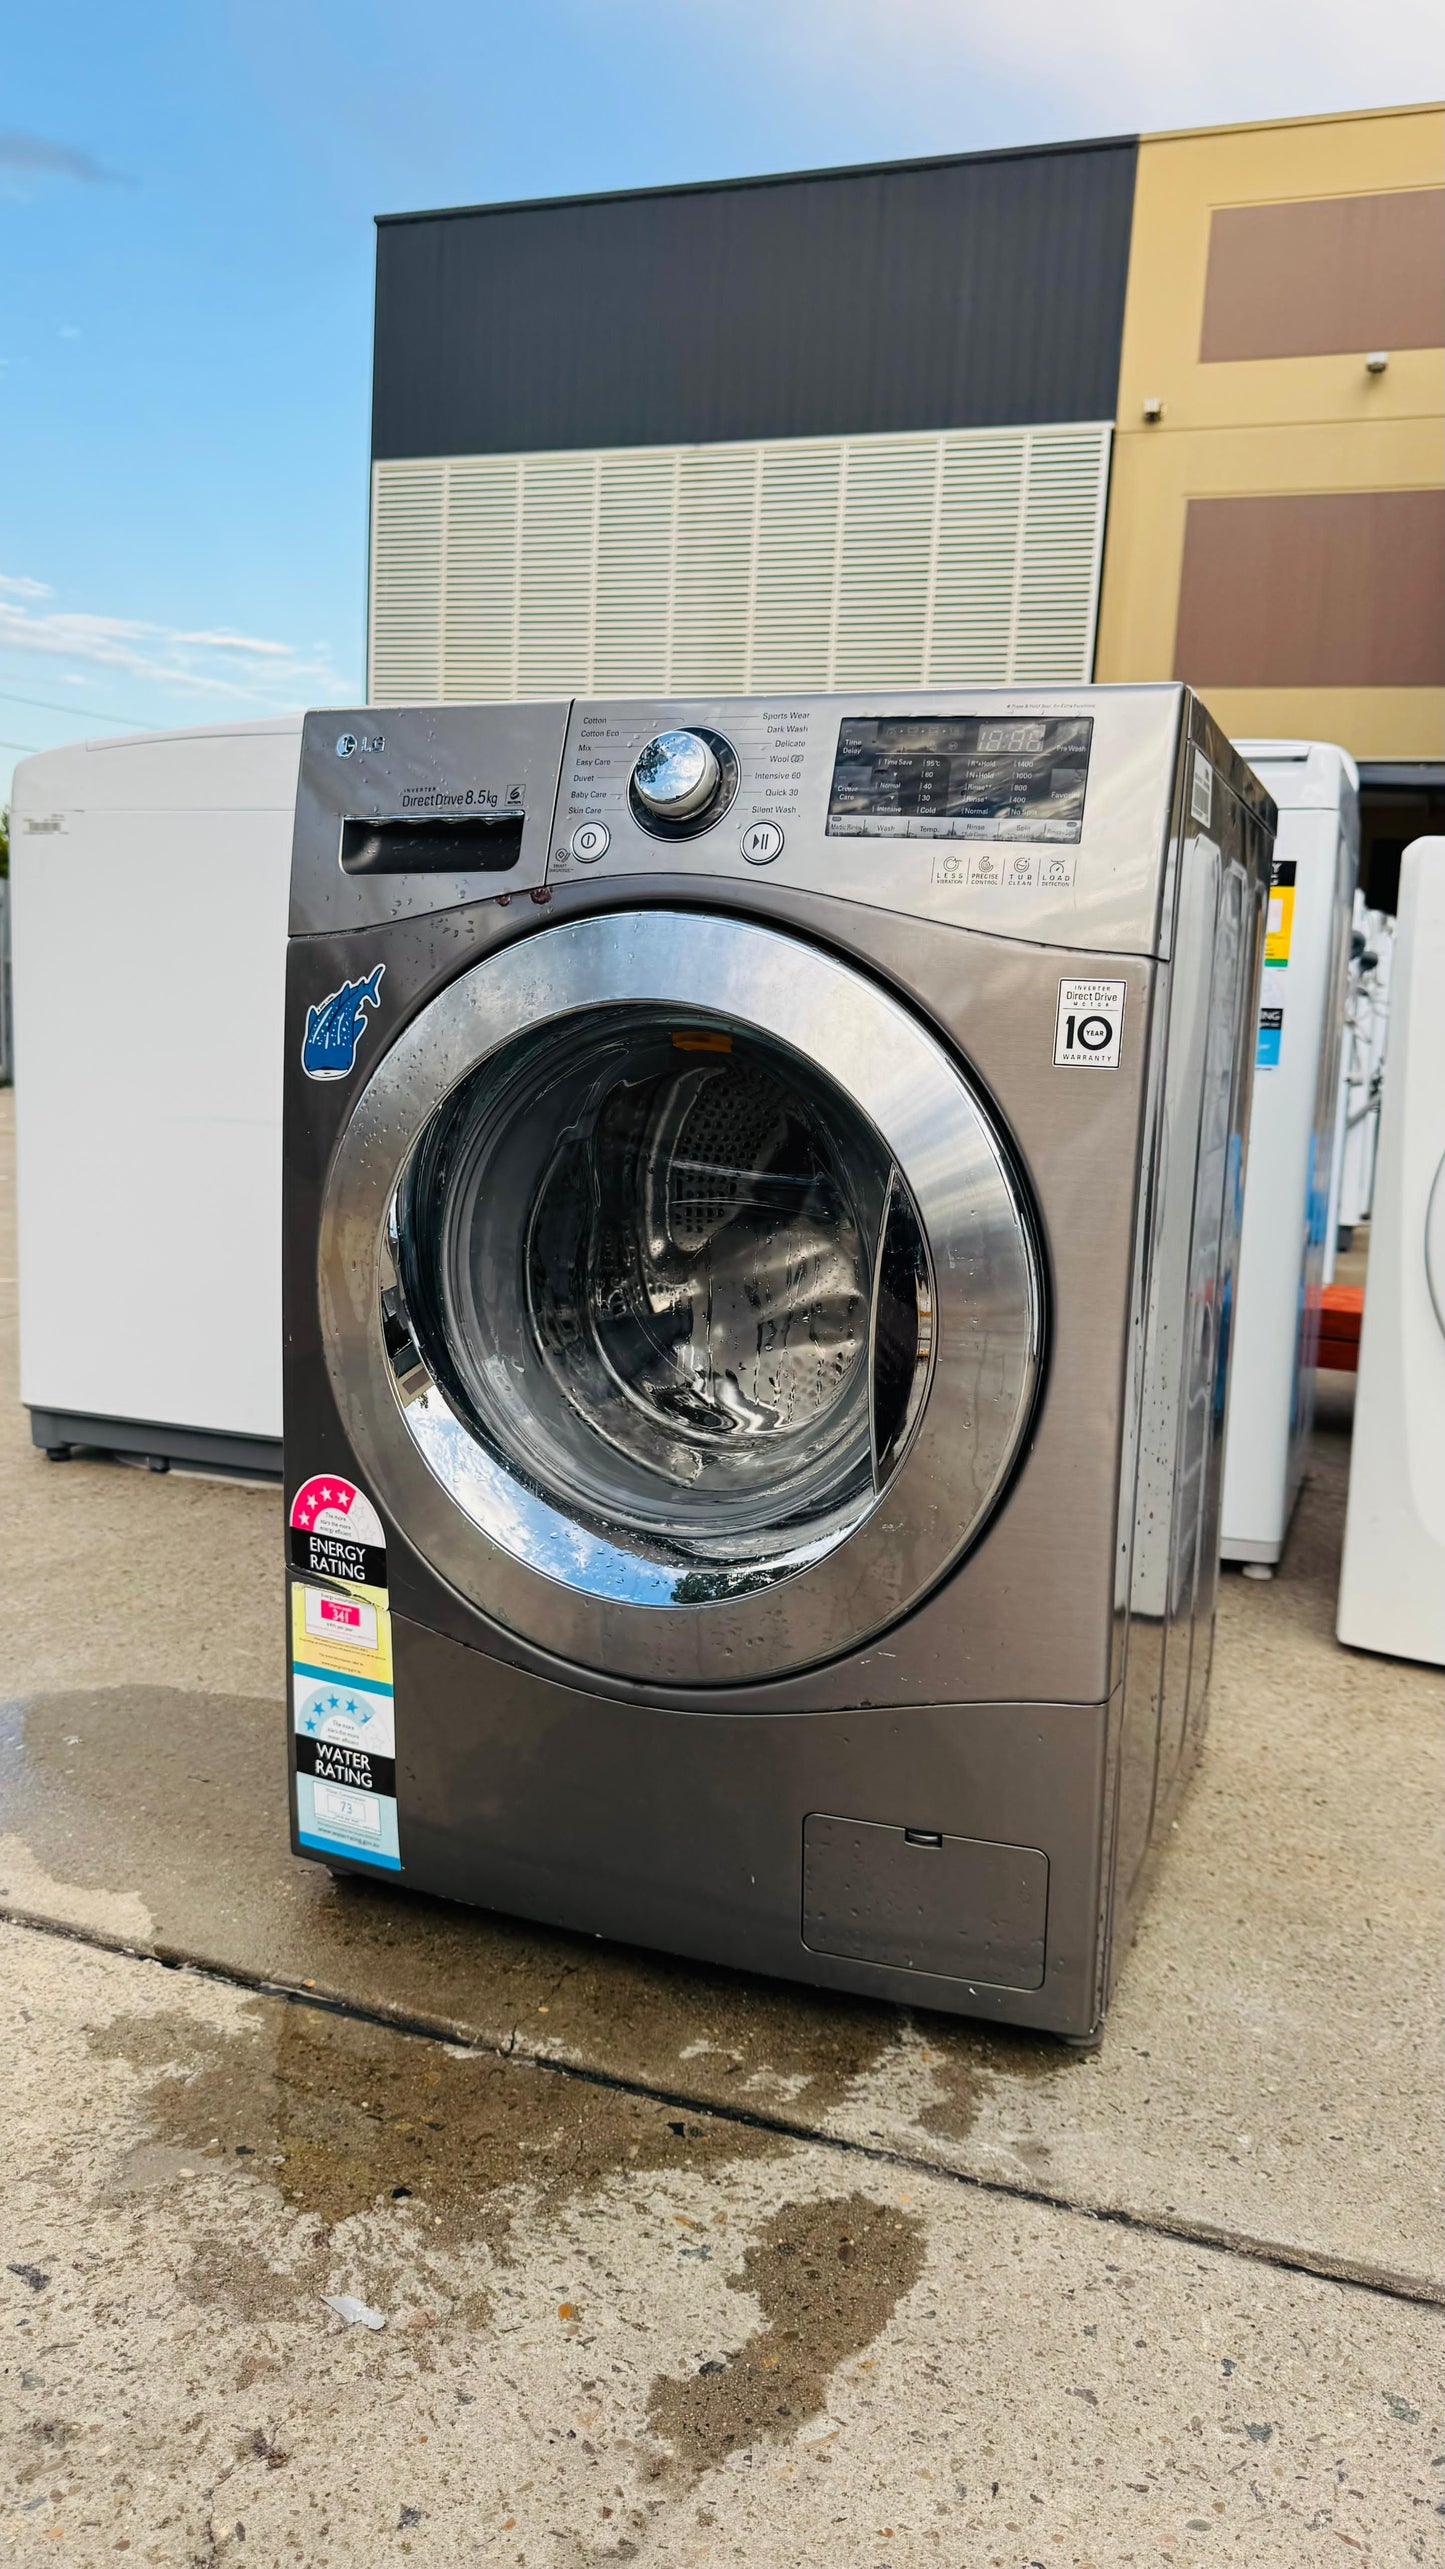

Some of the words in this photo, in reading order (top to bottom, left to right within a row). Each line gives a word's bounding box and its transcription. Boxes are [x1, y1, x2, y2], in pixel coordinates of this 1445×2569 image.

[763, 712, 788, 720] Sports
[361, 736, 386, 752] LG
[576, 759, 593, 767] Easy
[573, 774, 594, 782] Duvet
[571, 791, 592, 799] Baby
[765, 788, 787, 797] Quick
[465, 789, 498, 807] 8.5kg
[752, 806, 773, 814] Silent
[775, 805, 797, 813] Wash
[920, 806, 937, 814] Cold
[1066, 991, 1093, 1000] Direct
[1095, 992, 1118, 1001] Drive
[1066, 1015, 1113, 1051] 10
[1062, 1054, 1112, 1062] WARRANTY
[309, 1536, 366, 1563] ENERGY
[310, 1553, 366, 1581] RATING
[315, 1742, 371, 1771] WATER
[315, 1759, 373, 1788] RATING
[340, 1800, 353, 1815] 73
